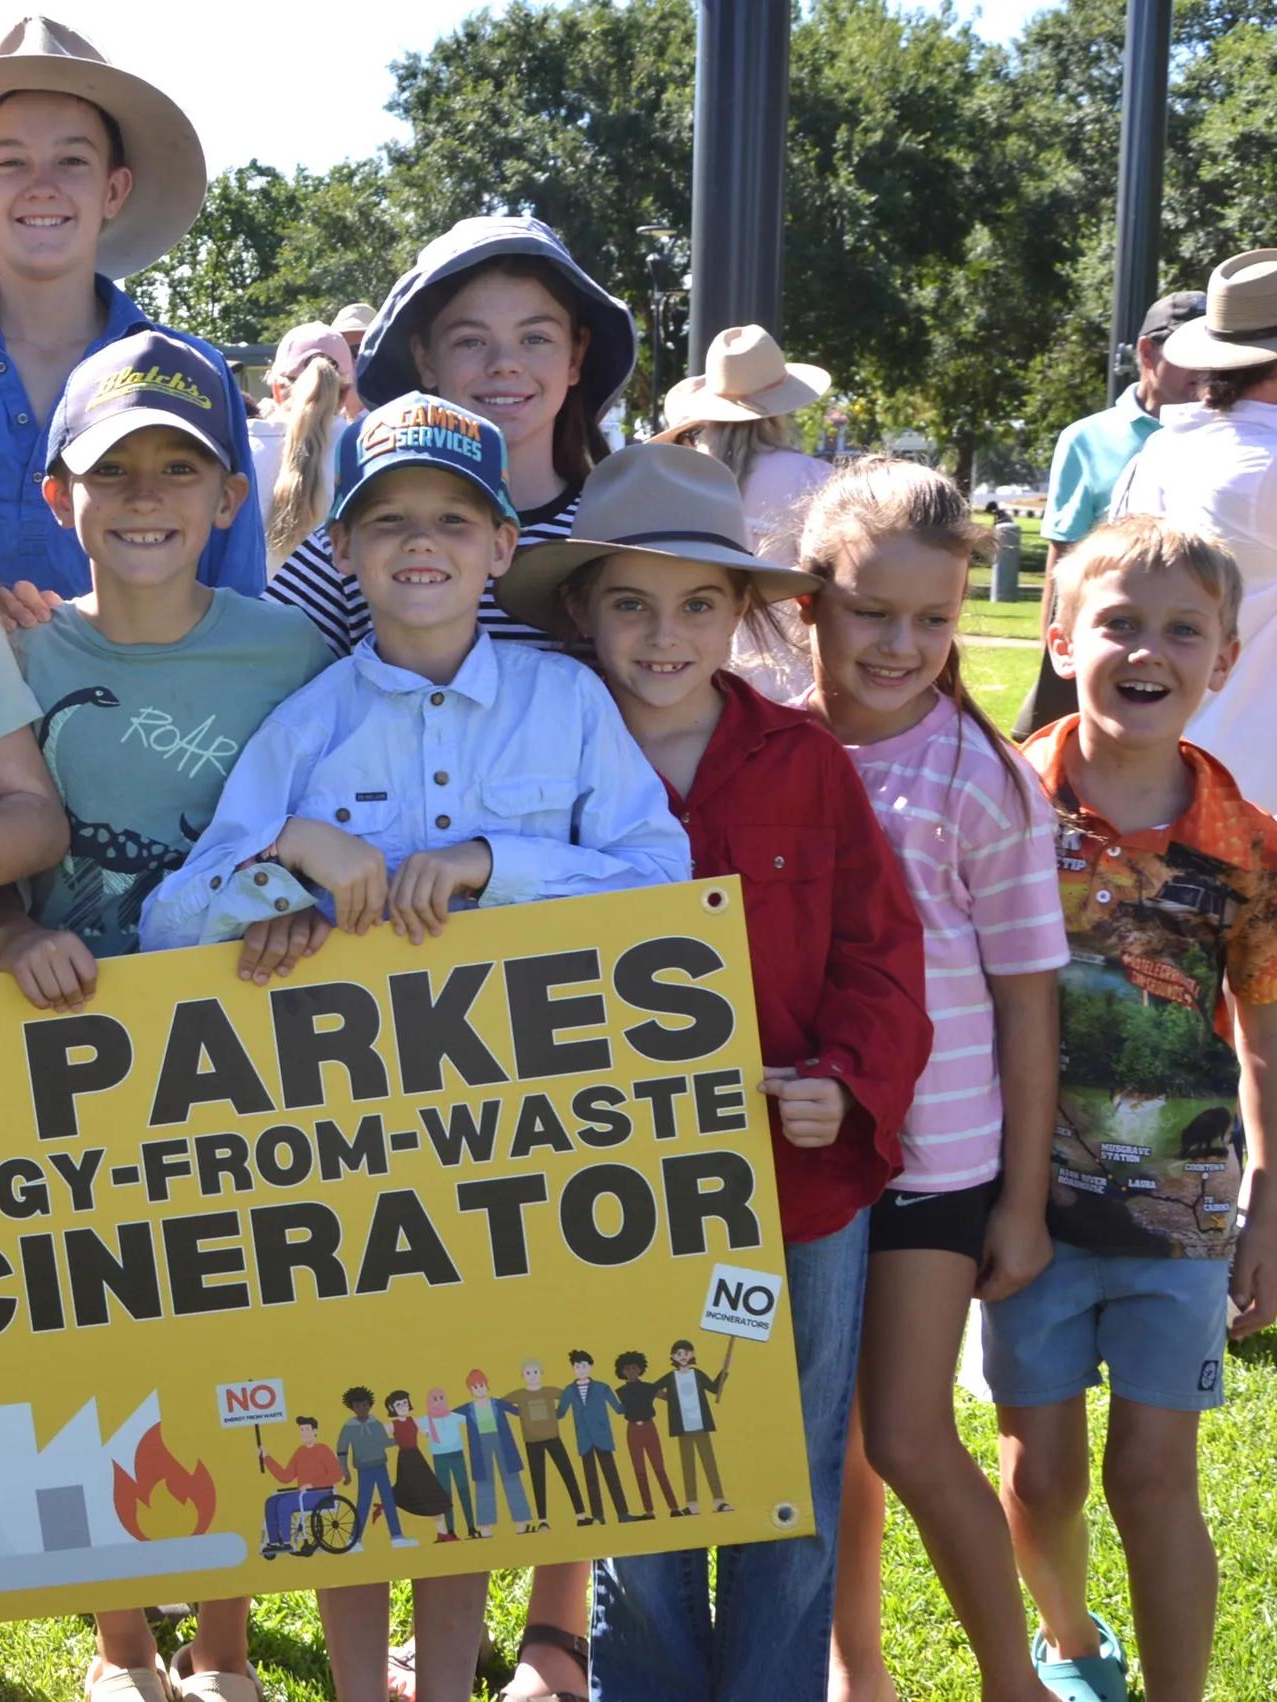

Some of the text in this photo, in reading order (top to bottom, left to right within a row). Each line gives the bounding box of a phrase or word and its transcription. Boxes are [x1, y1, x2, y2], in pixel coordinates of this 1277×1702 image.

[396, 426, 482, 462] SERVICES
[121, 706, 238, 778] ROAR
[22, 936, 735, 1140] PARKES
[1101, 1143, 1151, 1156] MUSGRAVE
[1101, 1152, 1140, 1163] STATION
[713, 1278, 775, 1316] NO
[705, 1310, 770, 1330] INCINERATORS
[226, 1384, 276, 1413] NO
